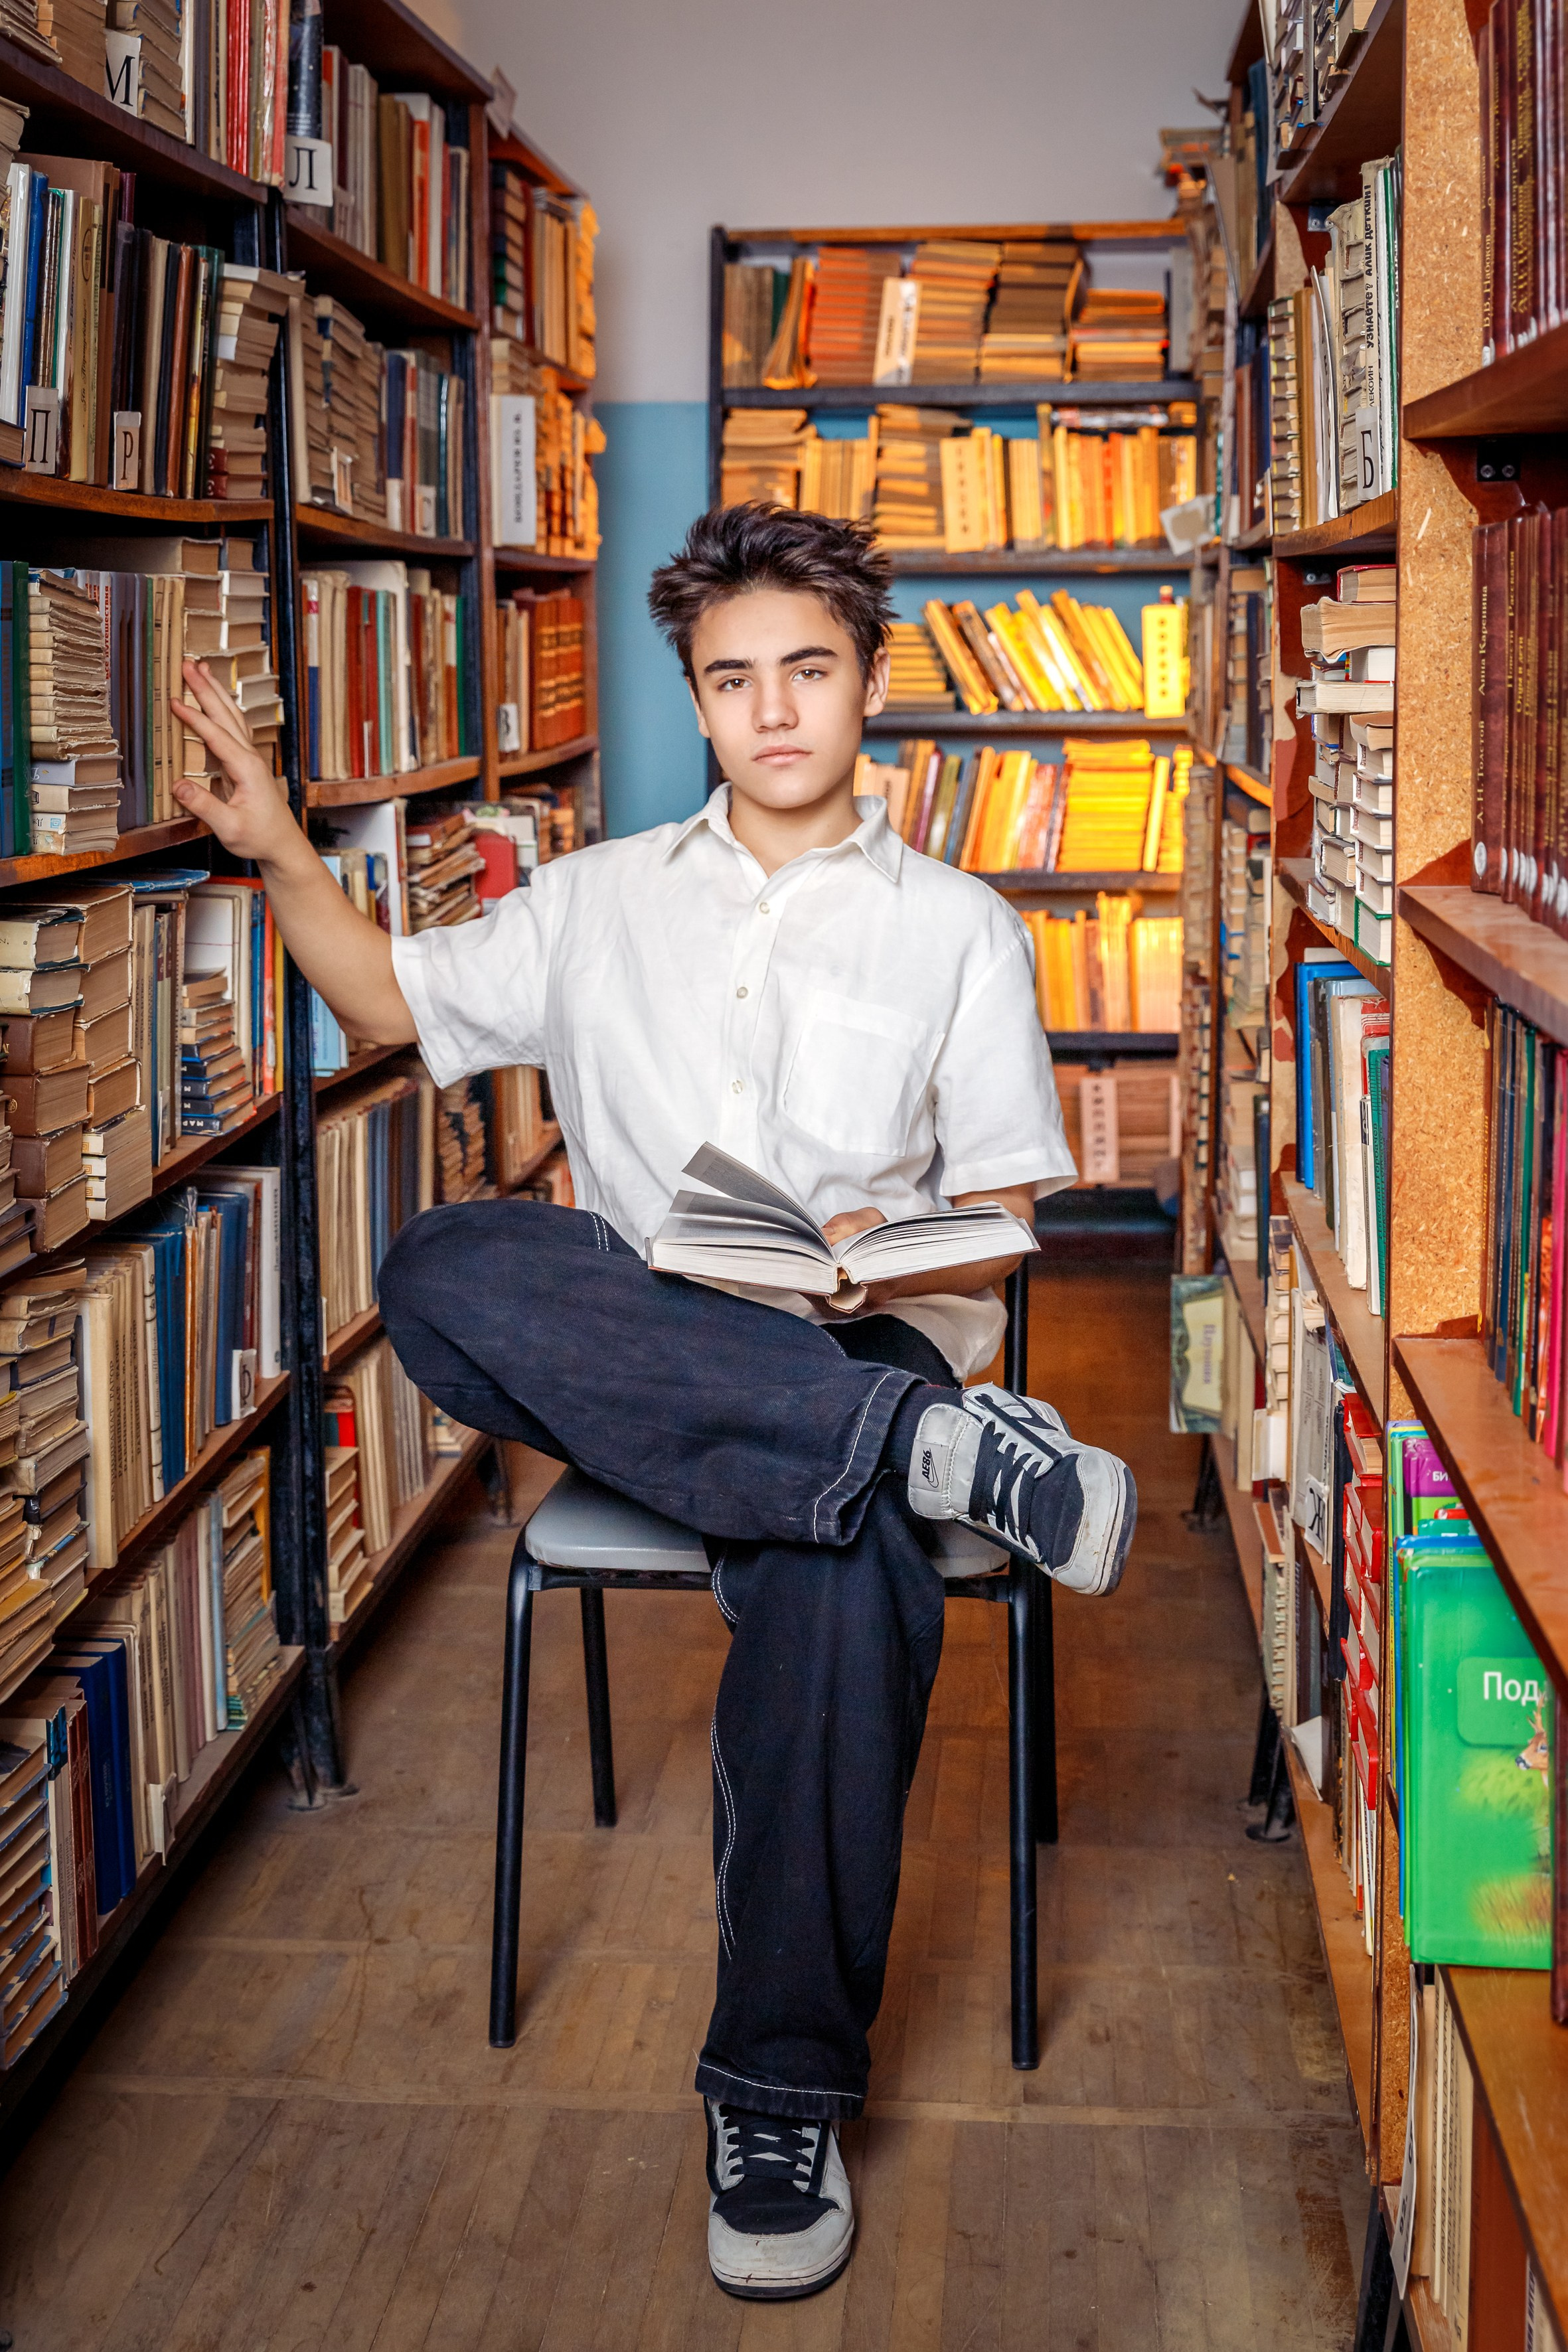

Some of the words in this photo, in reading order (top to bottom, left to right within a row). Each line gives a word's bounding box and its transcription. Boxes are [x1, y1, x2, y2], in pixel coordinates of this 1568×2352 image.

[106, 56, 135, 106] М
[289, 147, 318, 190] Л
[29, 408, 51, 464] П
[121, 430, 133, 481] Р
[1361, 430, 1374, 489] Б
[1478, 586, 1488, 655] Каренина
[921, 1449, 932, 1480] AE86
[1432, 1470, 1451, 1482] БИ
[1443, 2069, 1448, 2097] ПО
